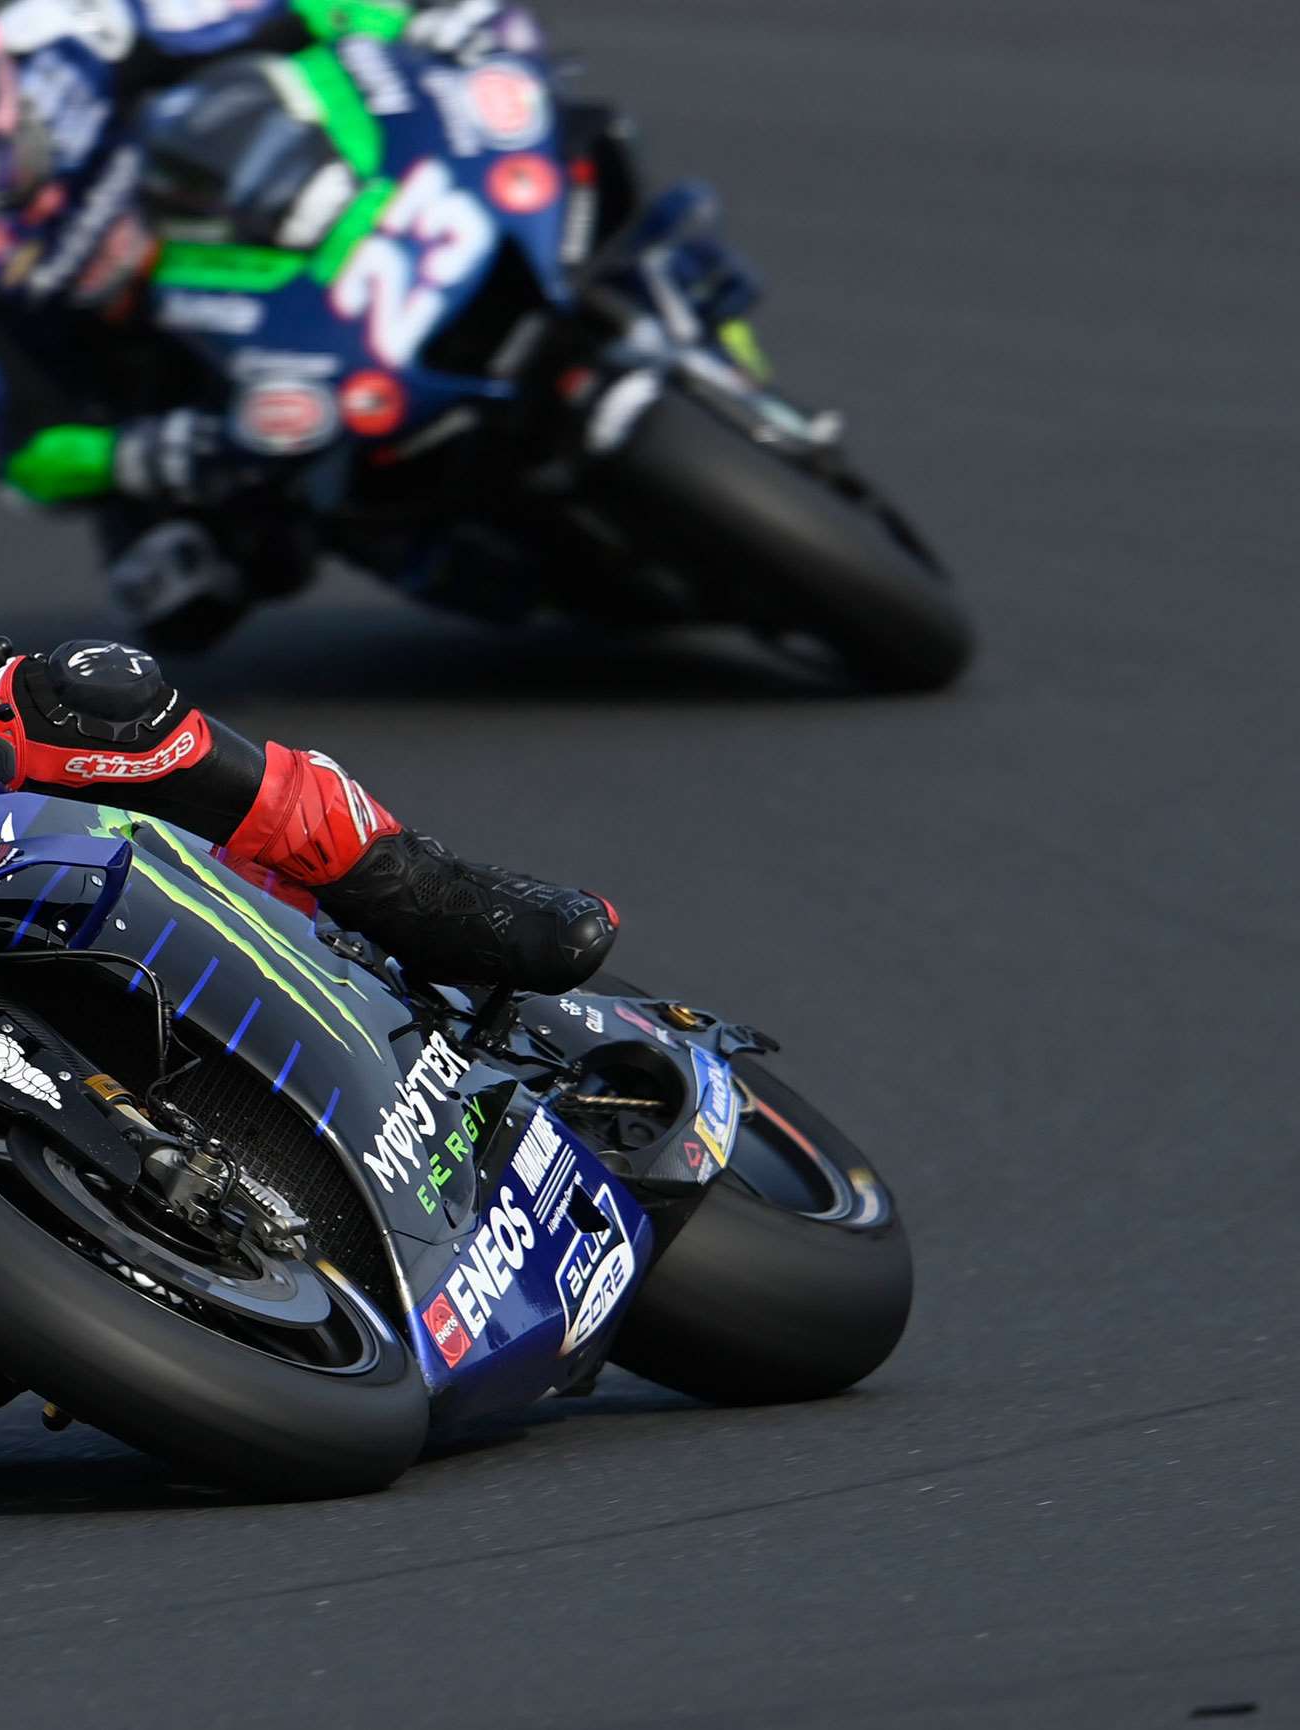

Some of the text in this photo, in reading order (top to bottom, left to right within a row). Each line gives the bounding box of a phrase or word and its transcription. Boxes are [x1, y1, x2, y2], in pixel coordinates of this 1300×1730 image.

[332, 159, 494, 368] 23
[65, 731, 195, 778] alpinestars
[363, 1030, 471, 1194] MONSTER
[511, 1105, 562, 1196] YAMALUBE
[445, 1185, 535, 1340] ENEOS
[434, 1316, 459, 1345] ENEOS
